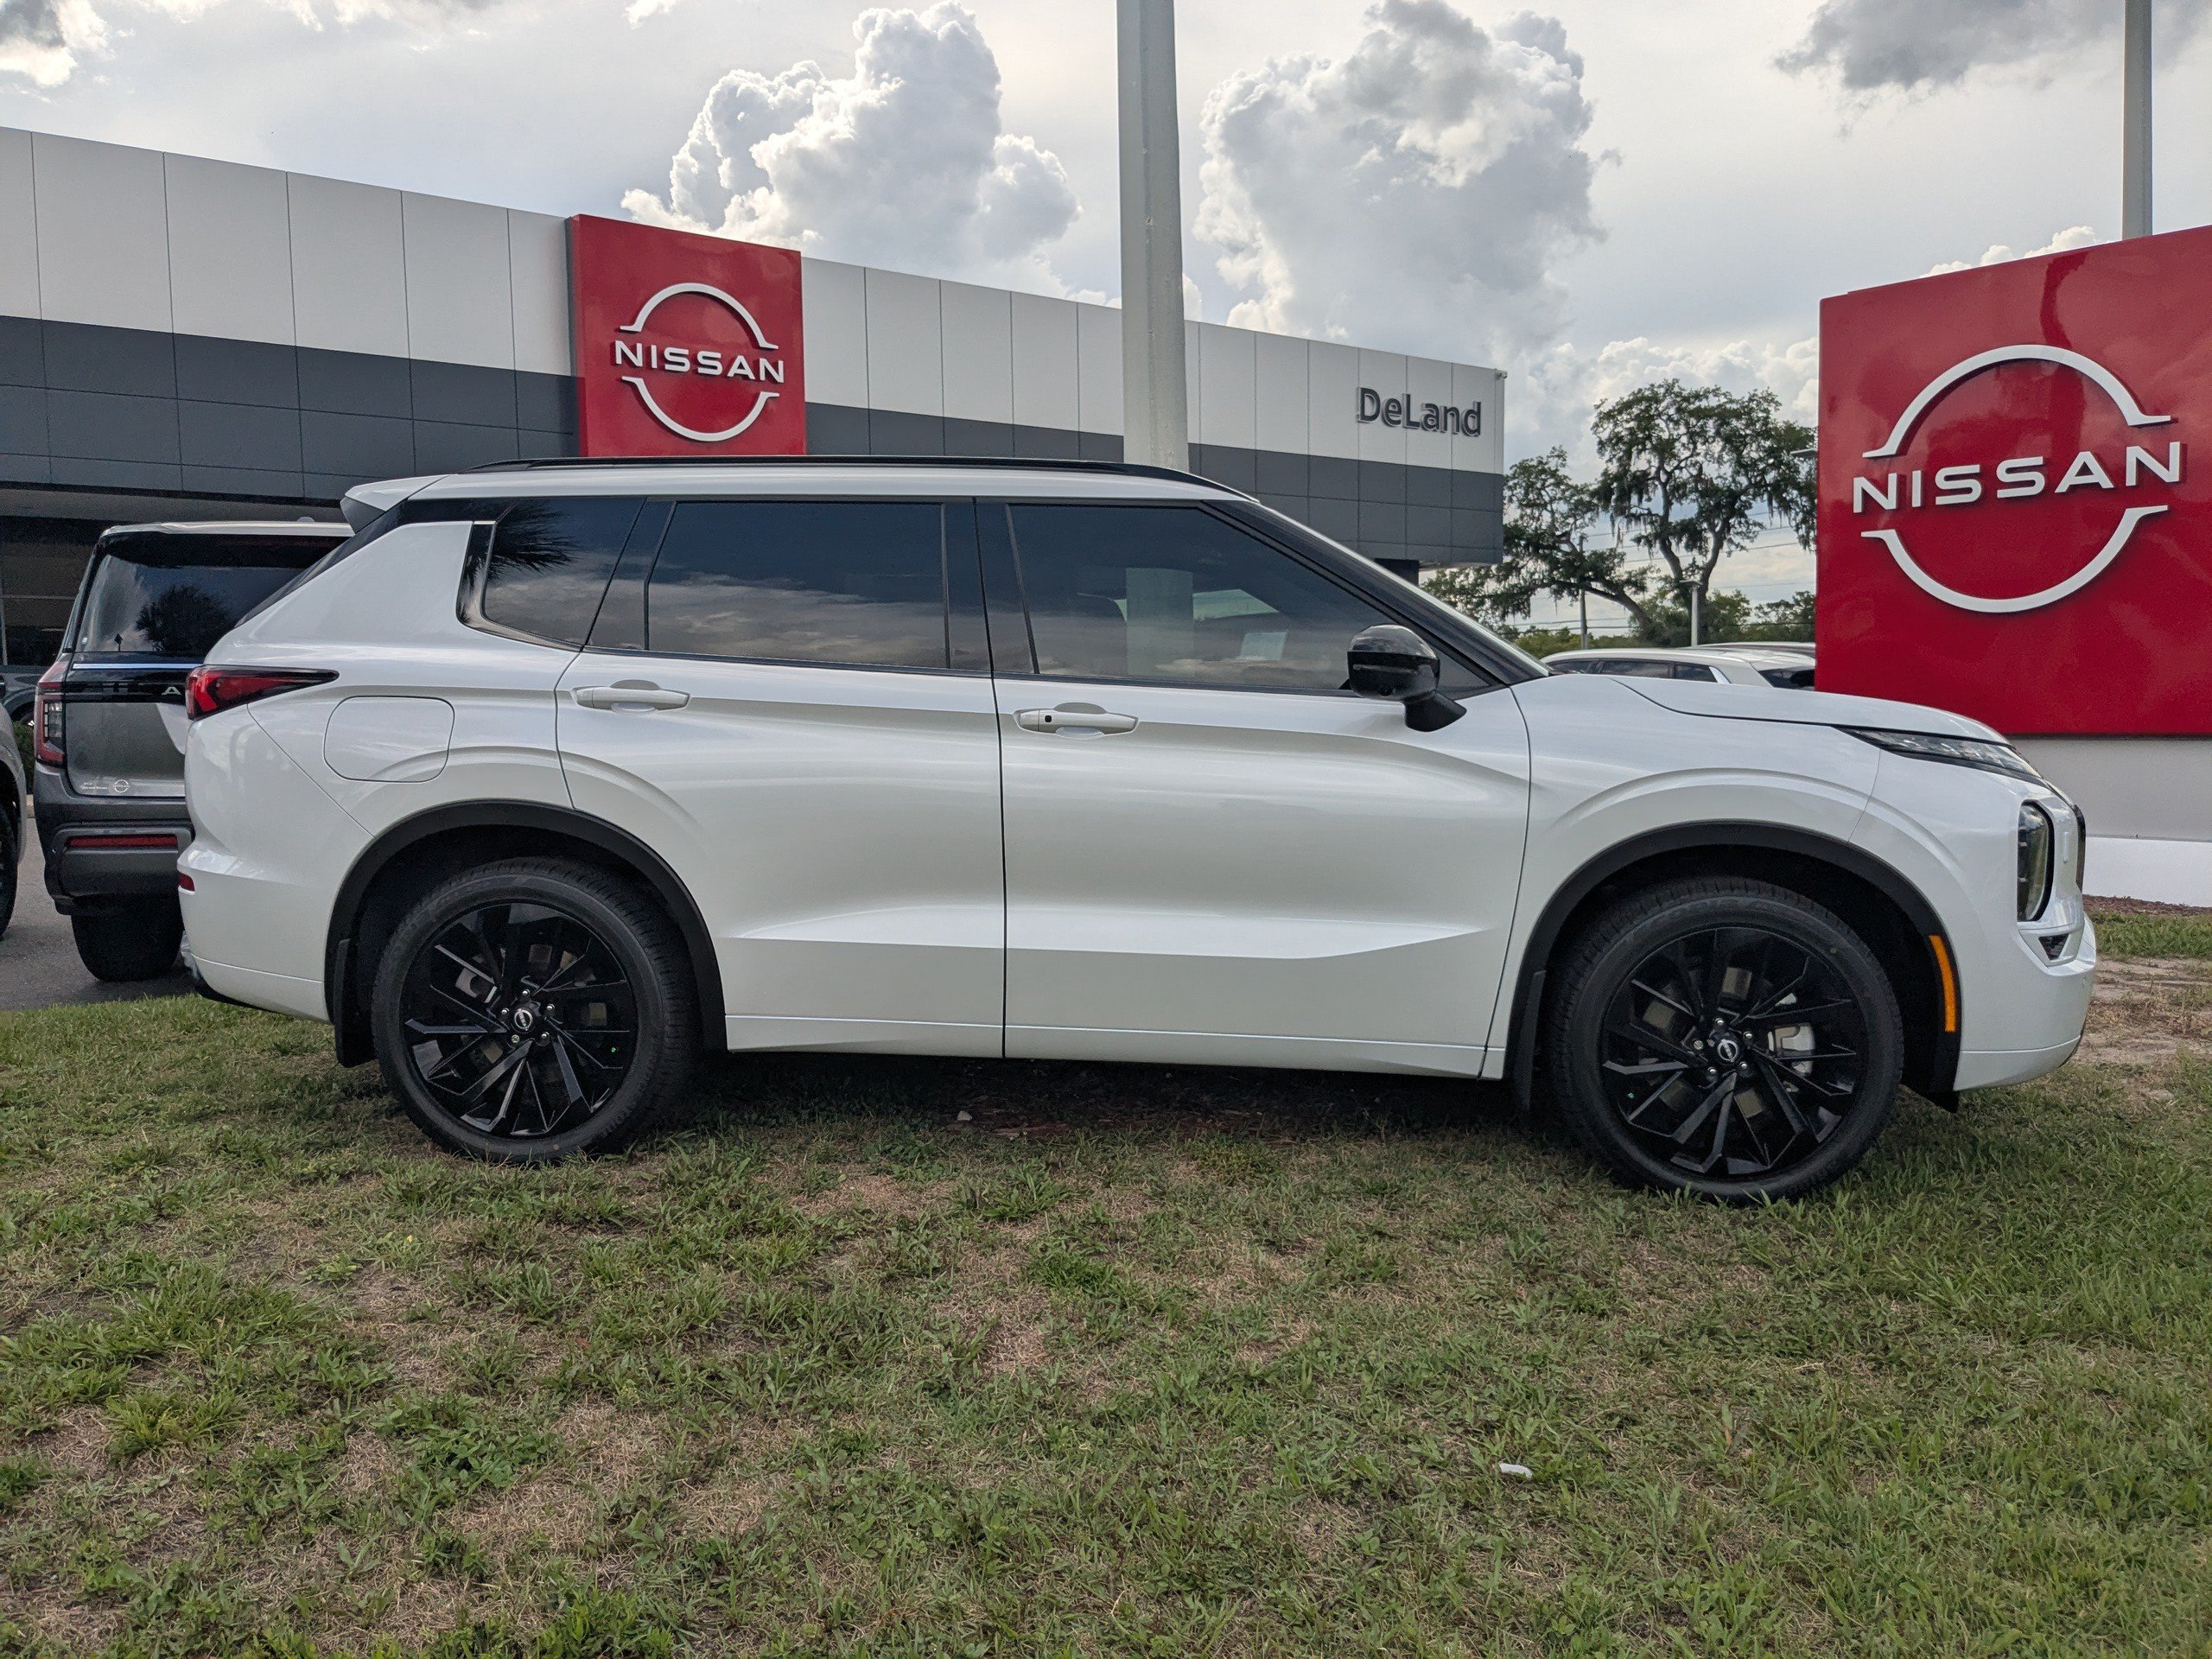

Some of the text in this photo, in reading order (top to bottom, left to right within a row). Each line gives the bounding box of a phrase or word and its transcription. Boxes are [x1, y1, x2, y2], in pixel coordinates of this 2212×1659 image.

[614, 340, 785, 384] NISSAN
[1359, 386, 1482, 436] DeLand
[1853, 441, 2181, 514] NISSAN
